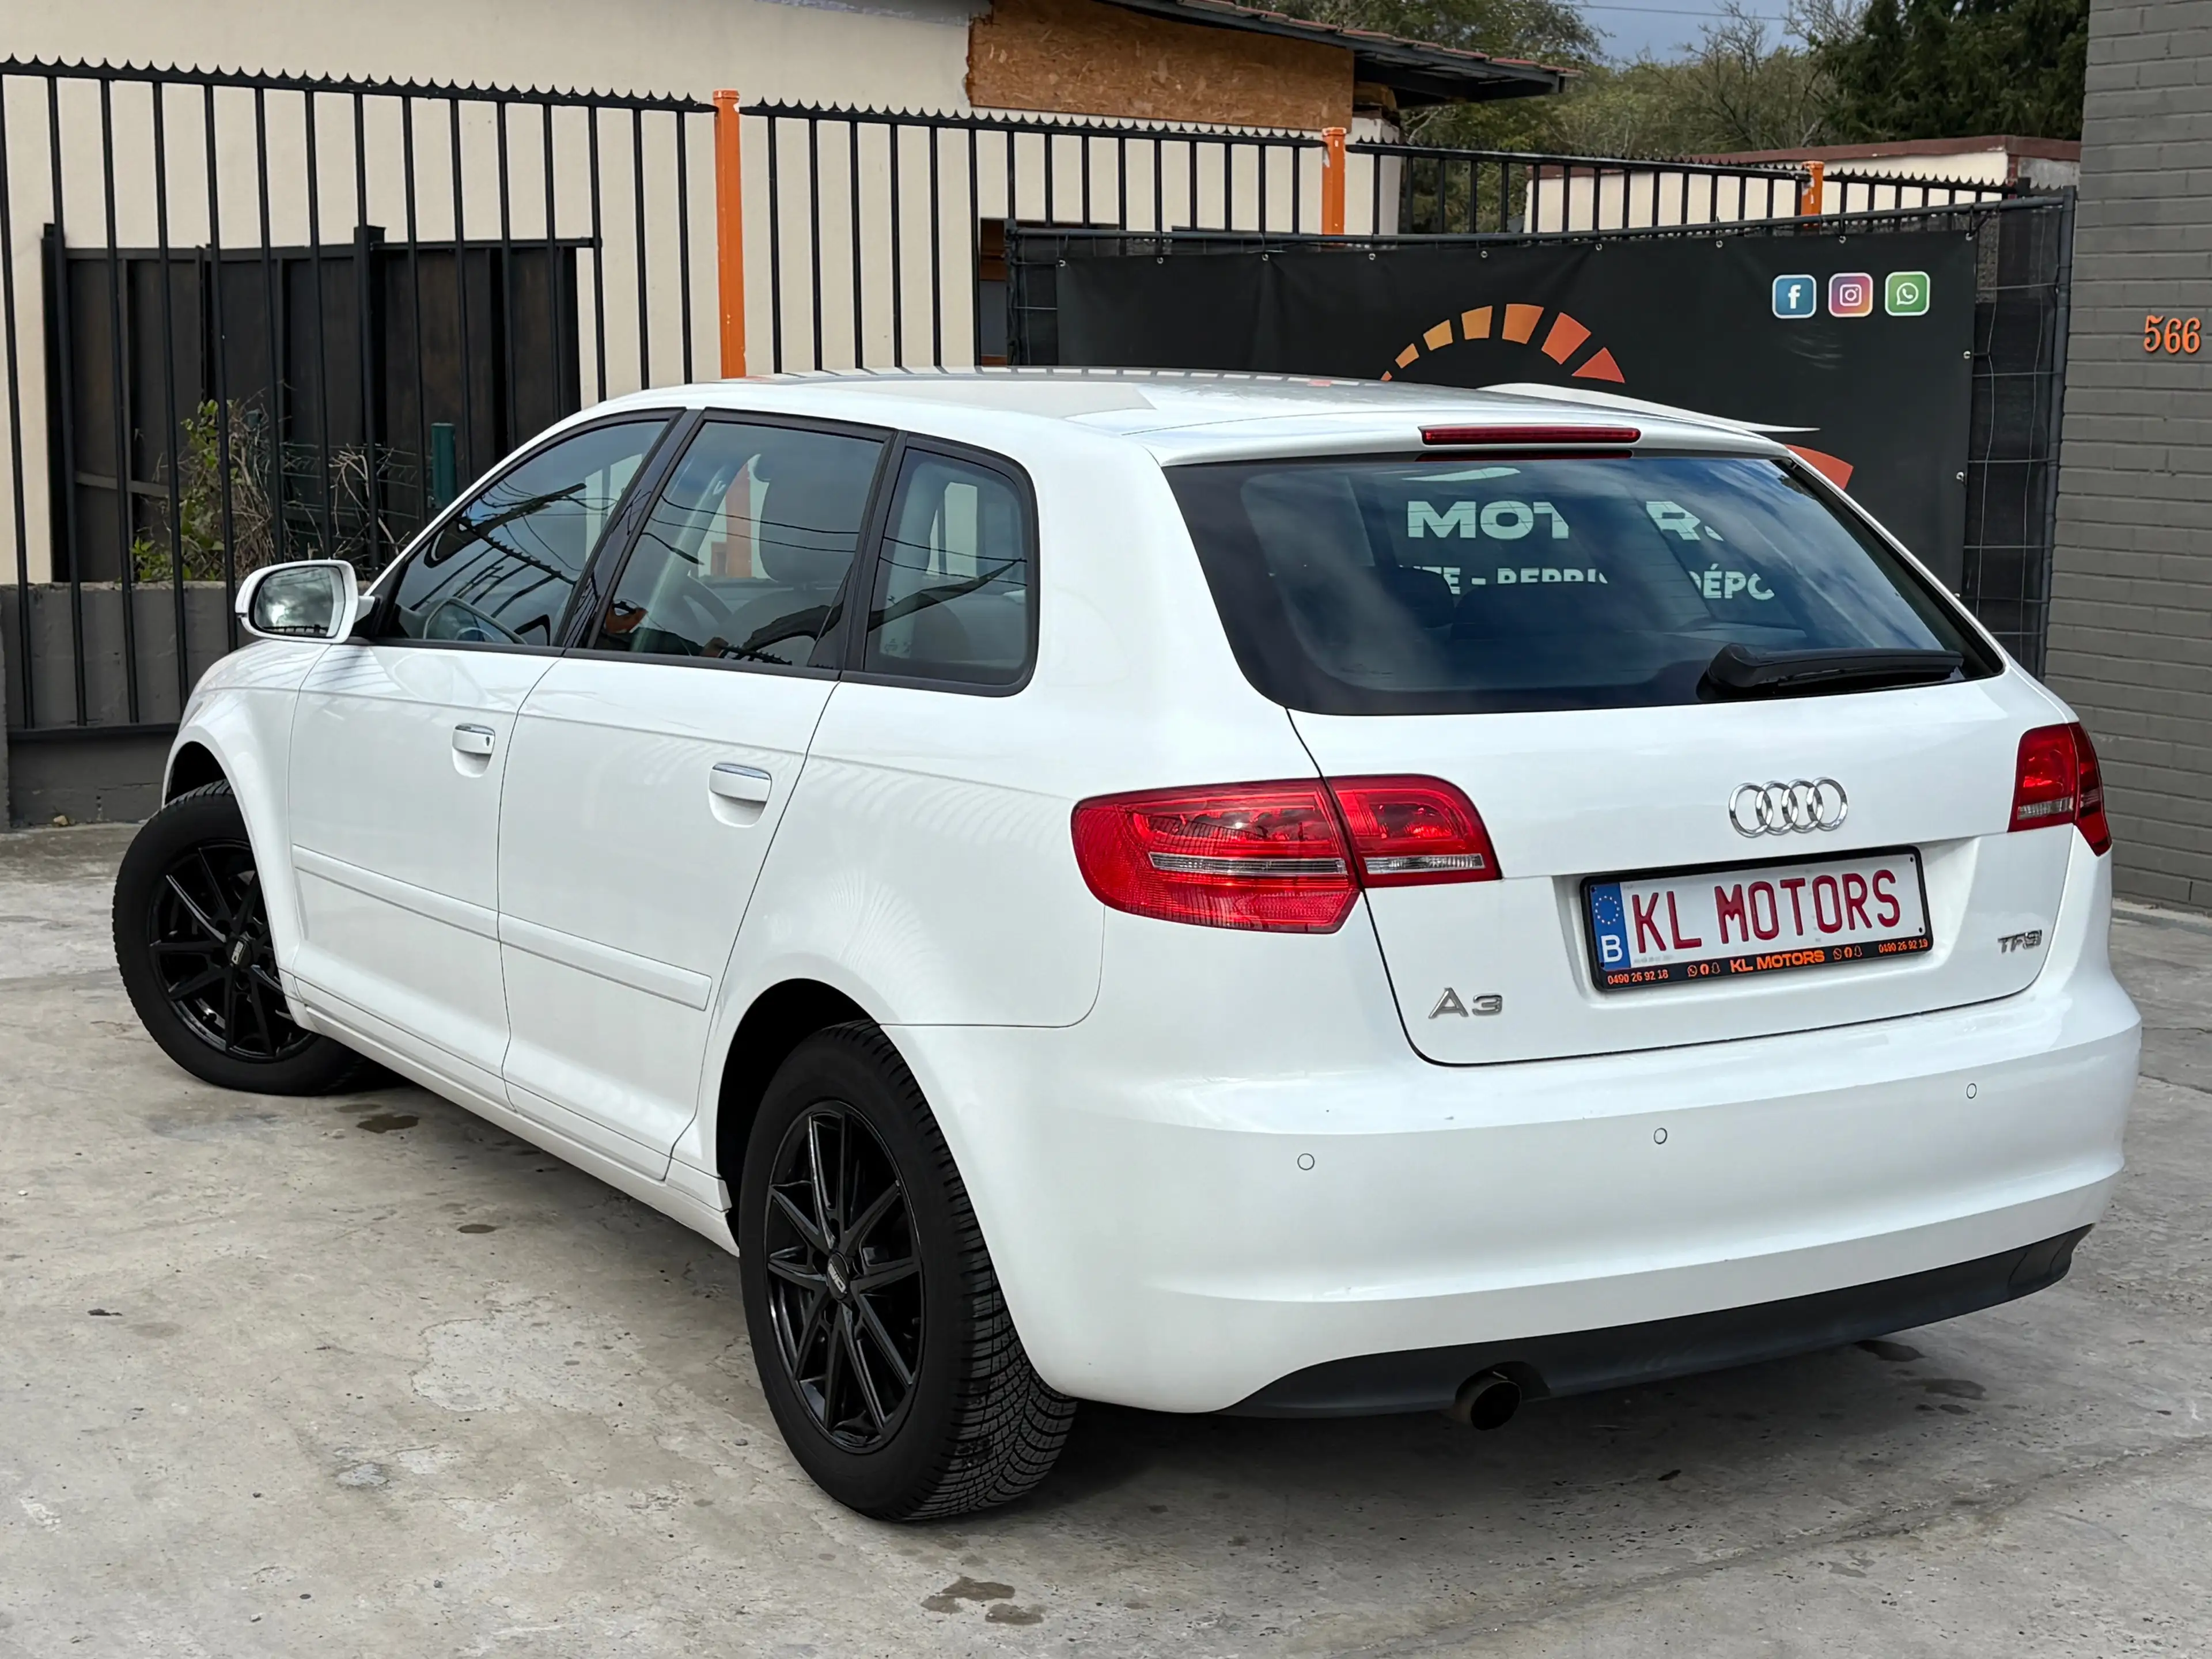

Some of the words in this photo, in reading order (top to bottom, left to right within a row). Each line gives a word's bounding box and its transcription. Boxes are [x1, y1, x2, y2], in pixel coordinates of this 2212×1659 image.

[2143, 315, 2201, 354] 566
[1633, 891, 1702, 953] KL
[1714, 869, 1900, 944] MOTORS
[1601, 934, 1623, 963] B
[1908, 940, 1918, 949] 92
[1730, 959, 1753, 973] KL
[1756, 950, 1825, 970] MOTORS
[1607, 974, 1629, 985] 0490
[1631, 972, 1642, 982] 26
[1644, 971, 1656, 981] 92
[1428, 987, 1503, 1019] A3
